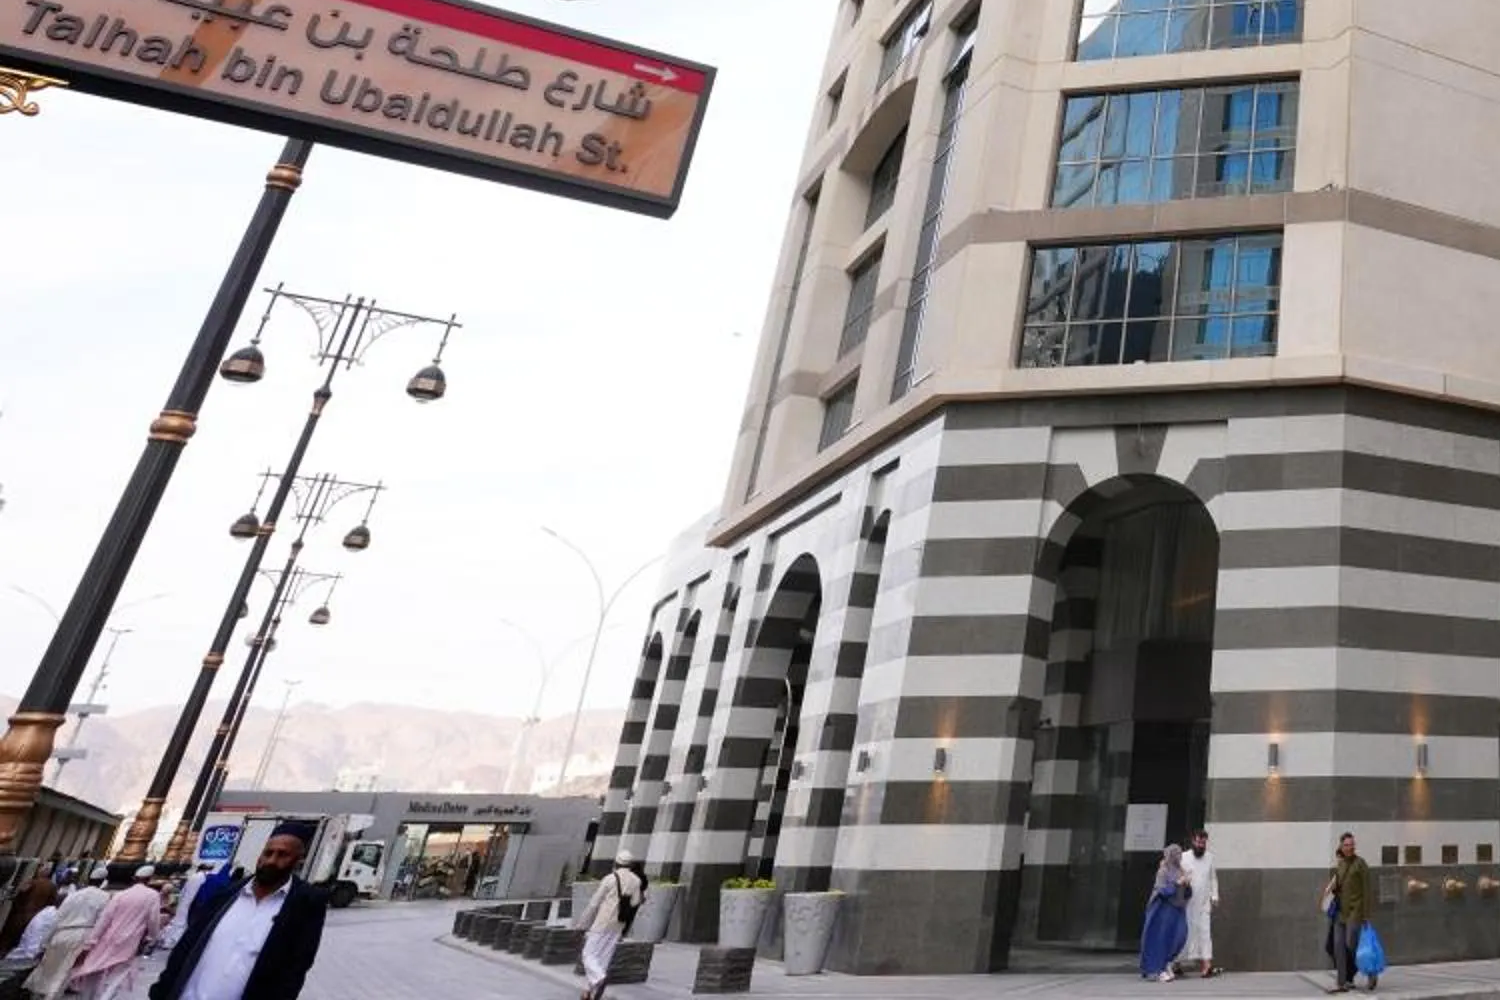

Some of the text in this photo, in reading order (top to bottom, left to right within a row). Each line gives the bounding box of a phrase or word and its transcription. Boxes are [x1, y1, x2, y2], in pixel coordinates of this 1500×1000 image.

[306, 9, 375, 61] بن
[387, 23, 531, 91] طلحة
[221, 46, 303, 96] bin
[319, 68, 564, 158] Ubaidullah
[575, 131, 629, 174] St.
[543, 69, 654, 121] شارع
